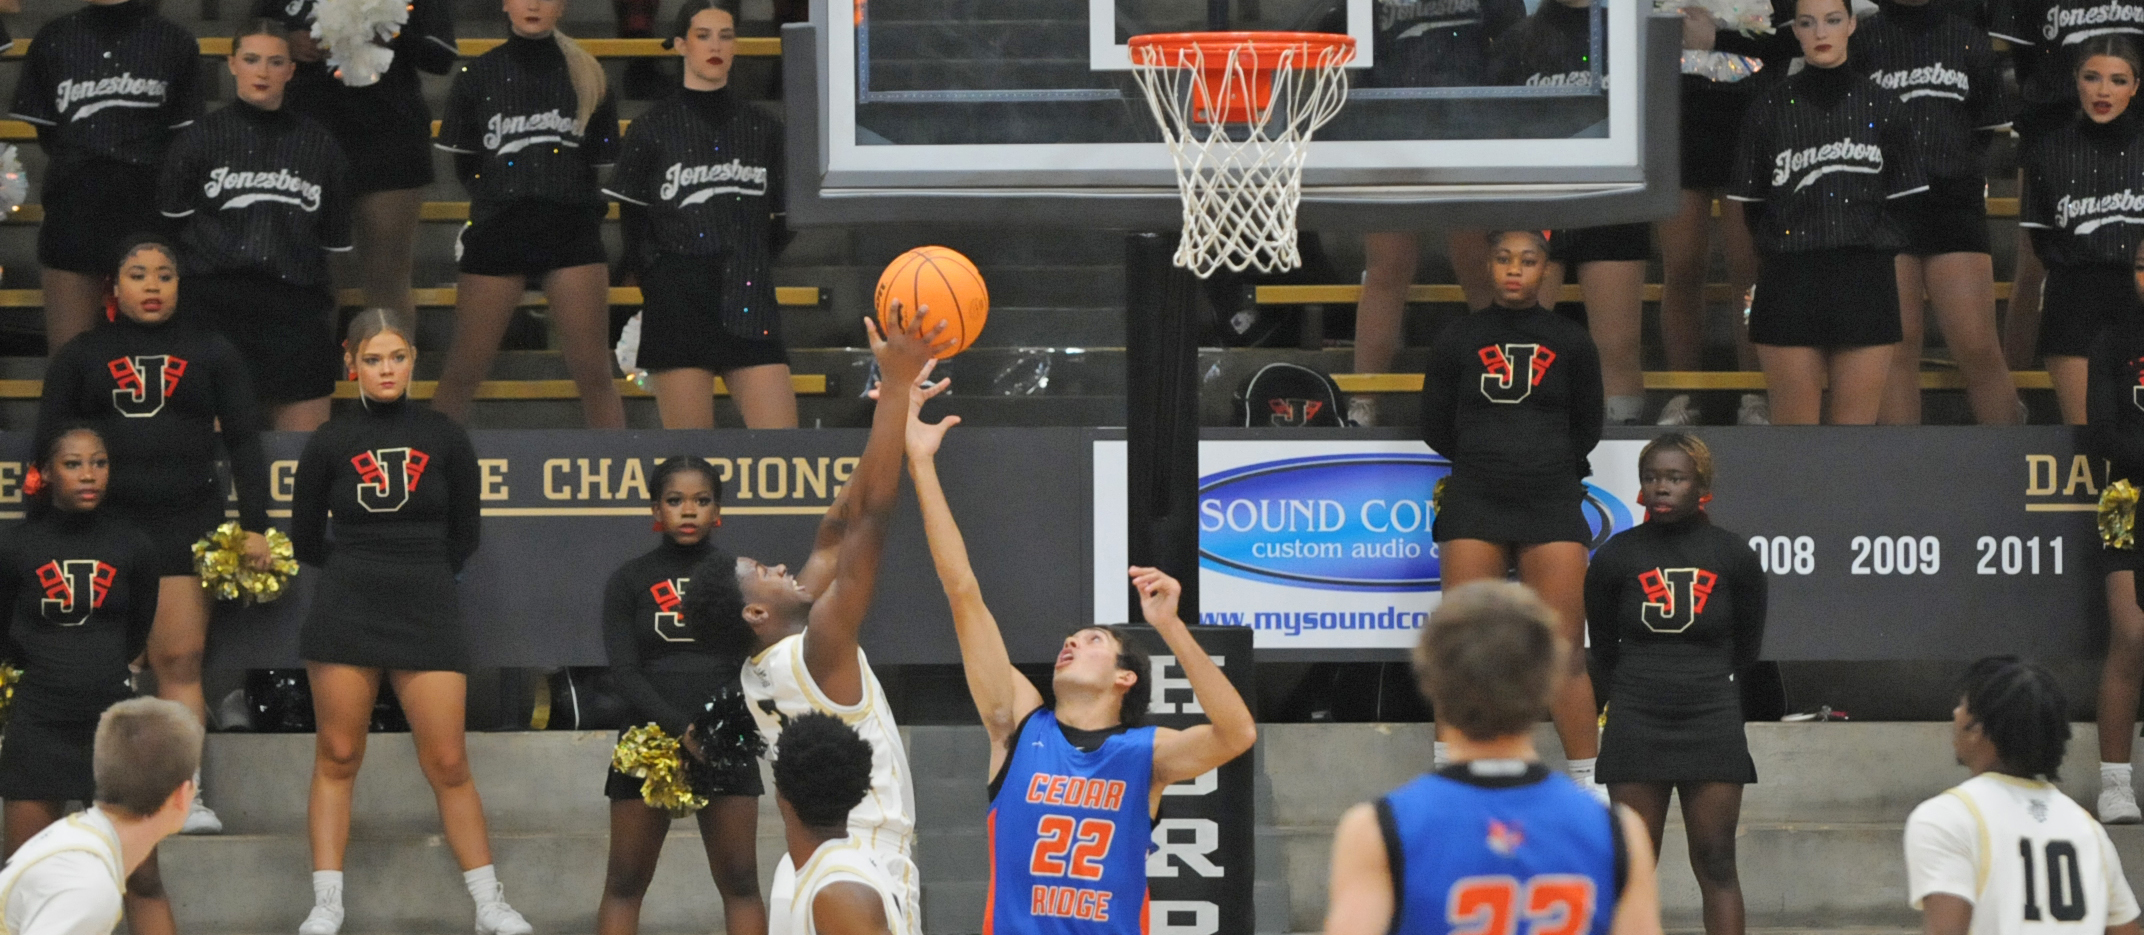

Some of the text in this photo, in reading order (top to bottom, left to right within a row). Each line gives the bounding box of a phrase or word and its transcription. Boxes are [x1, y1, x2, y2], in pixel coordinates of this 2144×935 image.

[204, 166, 321, 211] Jonesboro
[1200, 498, 1346, 533] SOUND
[1251, 539, 1343, 559] custom
[1351, 537, 1421, 559] audio
[1851, 536, 1941, 575] 2009
[1976, 536, 2064, 575] 2011
[1026, 773, 1126, 811] CEDAR
[1030, 813, 1115, 881] 22
[2019, 837, 2087, 922] 10
[1031, 886, 1112, 922] RIDGE
